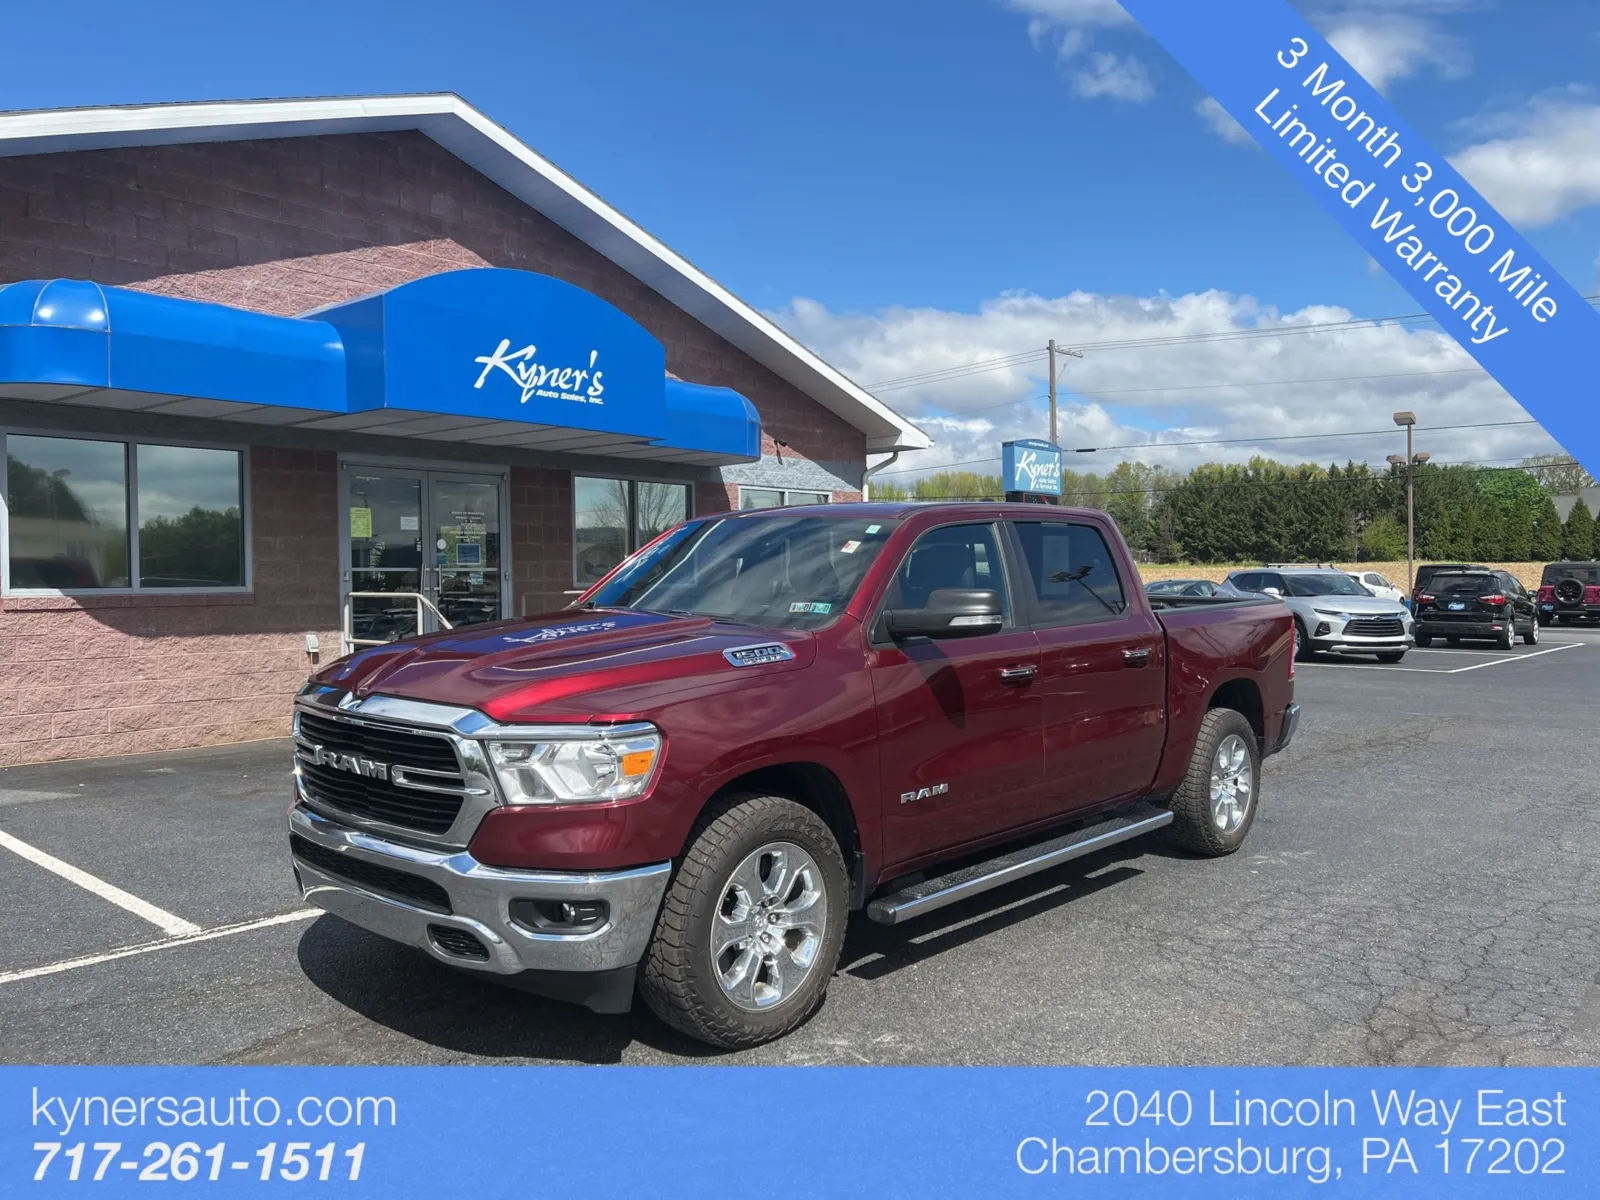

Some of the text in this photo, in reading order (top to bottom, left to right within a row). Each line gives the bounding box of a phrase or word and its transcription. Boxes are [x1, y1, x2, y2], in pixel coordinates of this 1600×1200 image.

[473, 338, 605, 404] Kyner's
[536, 389, 604, 405] Auto Sales, Inc.
[1015, 450, 1060, 490] Kyner's
[733, 646, 781, 660] 1500
[314, 745, 388, 780] RAM
[900, 783, 949, 804] RAM
